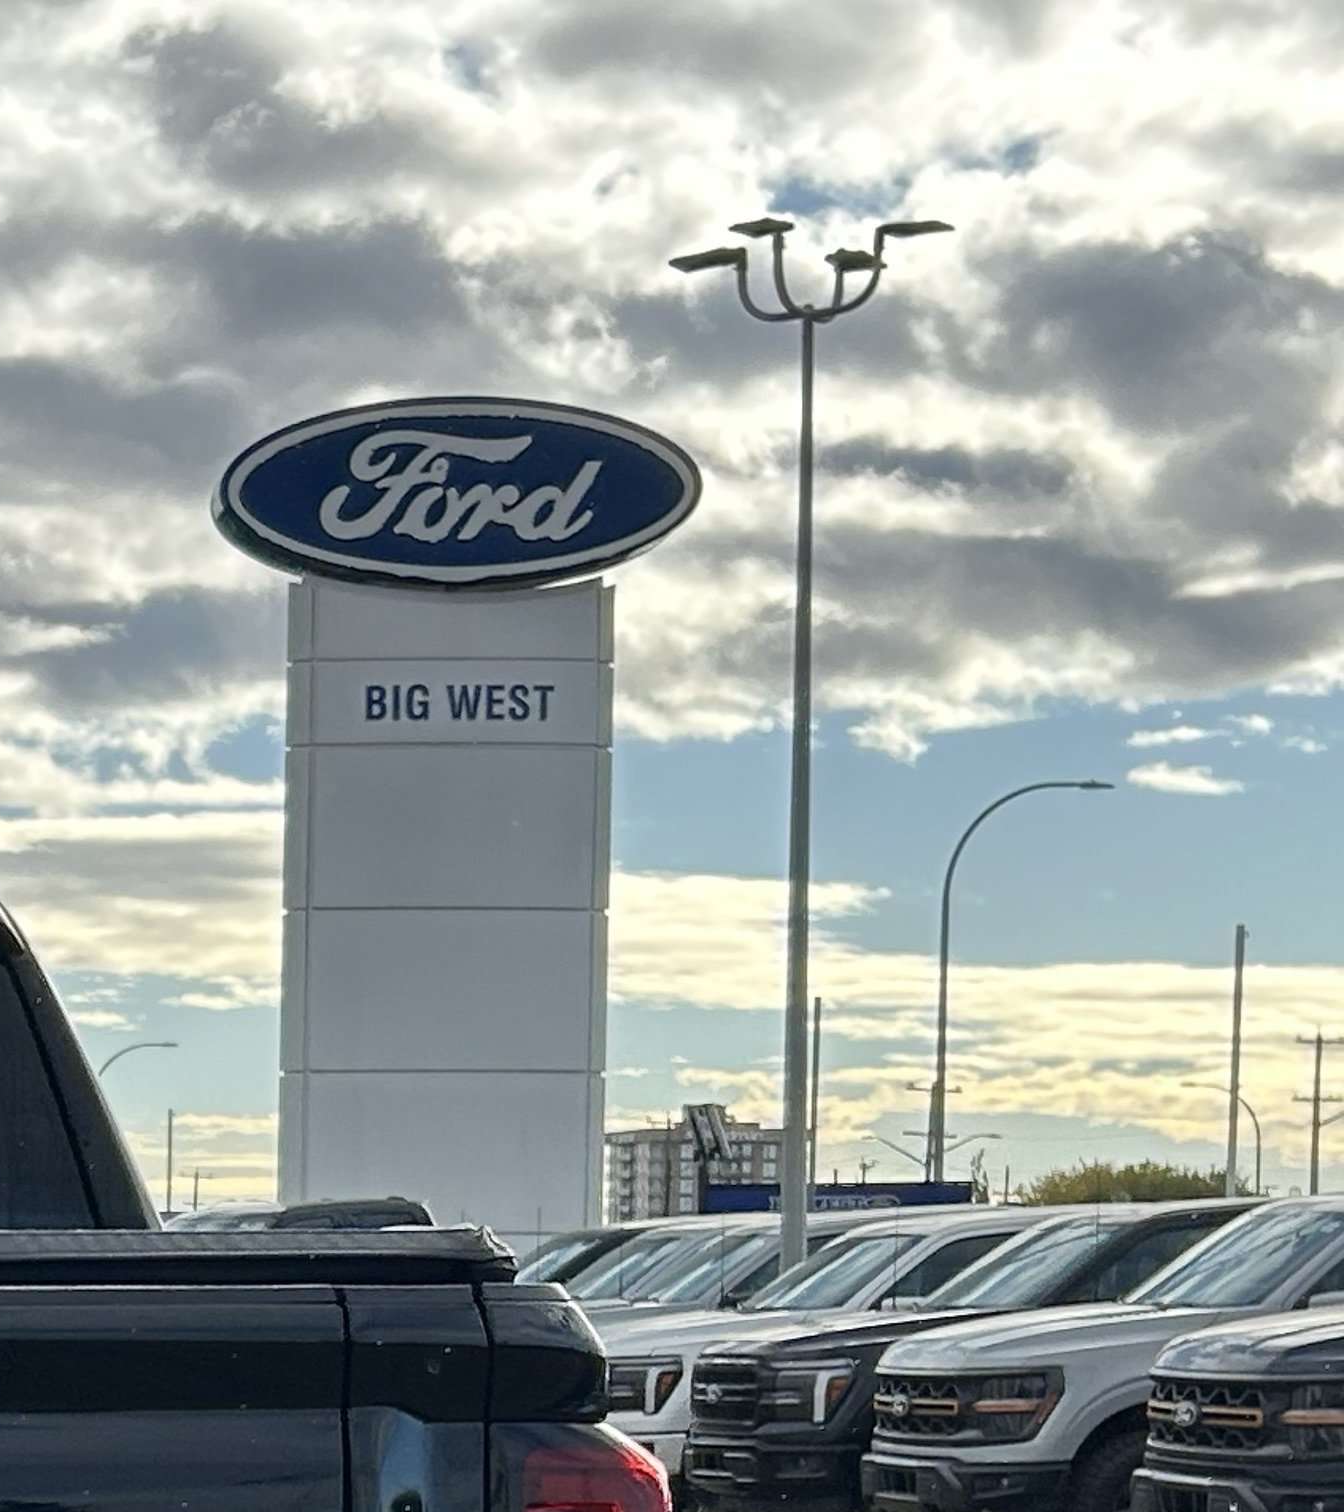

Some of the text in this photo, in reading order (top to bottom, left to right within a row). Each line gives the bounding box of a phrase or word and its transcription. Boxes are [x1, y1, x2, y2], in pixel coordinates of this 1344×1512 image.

[320, 430, 603, 543] Ford
[364, 683, 555, 722] BIG WEST
